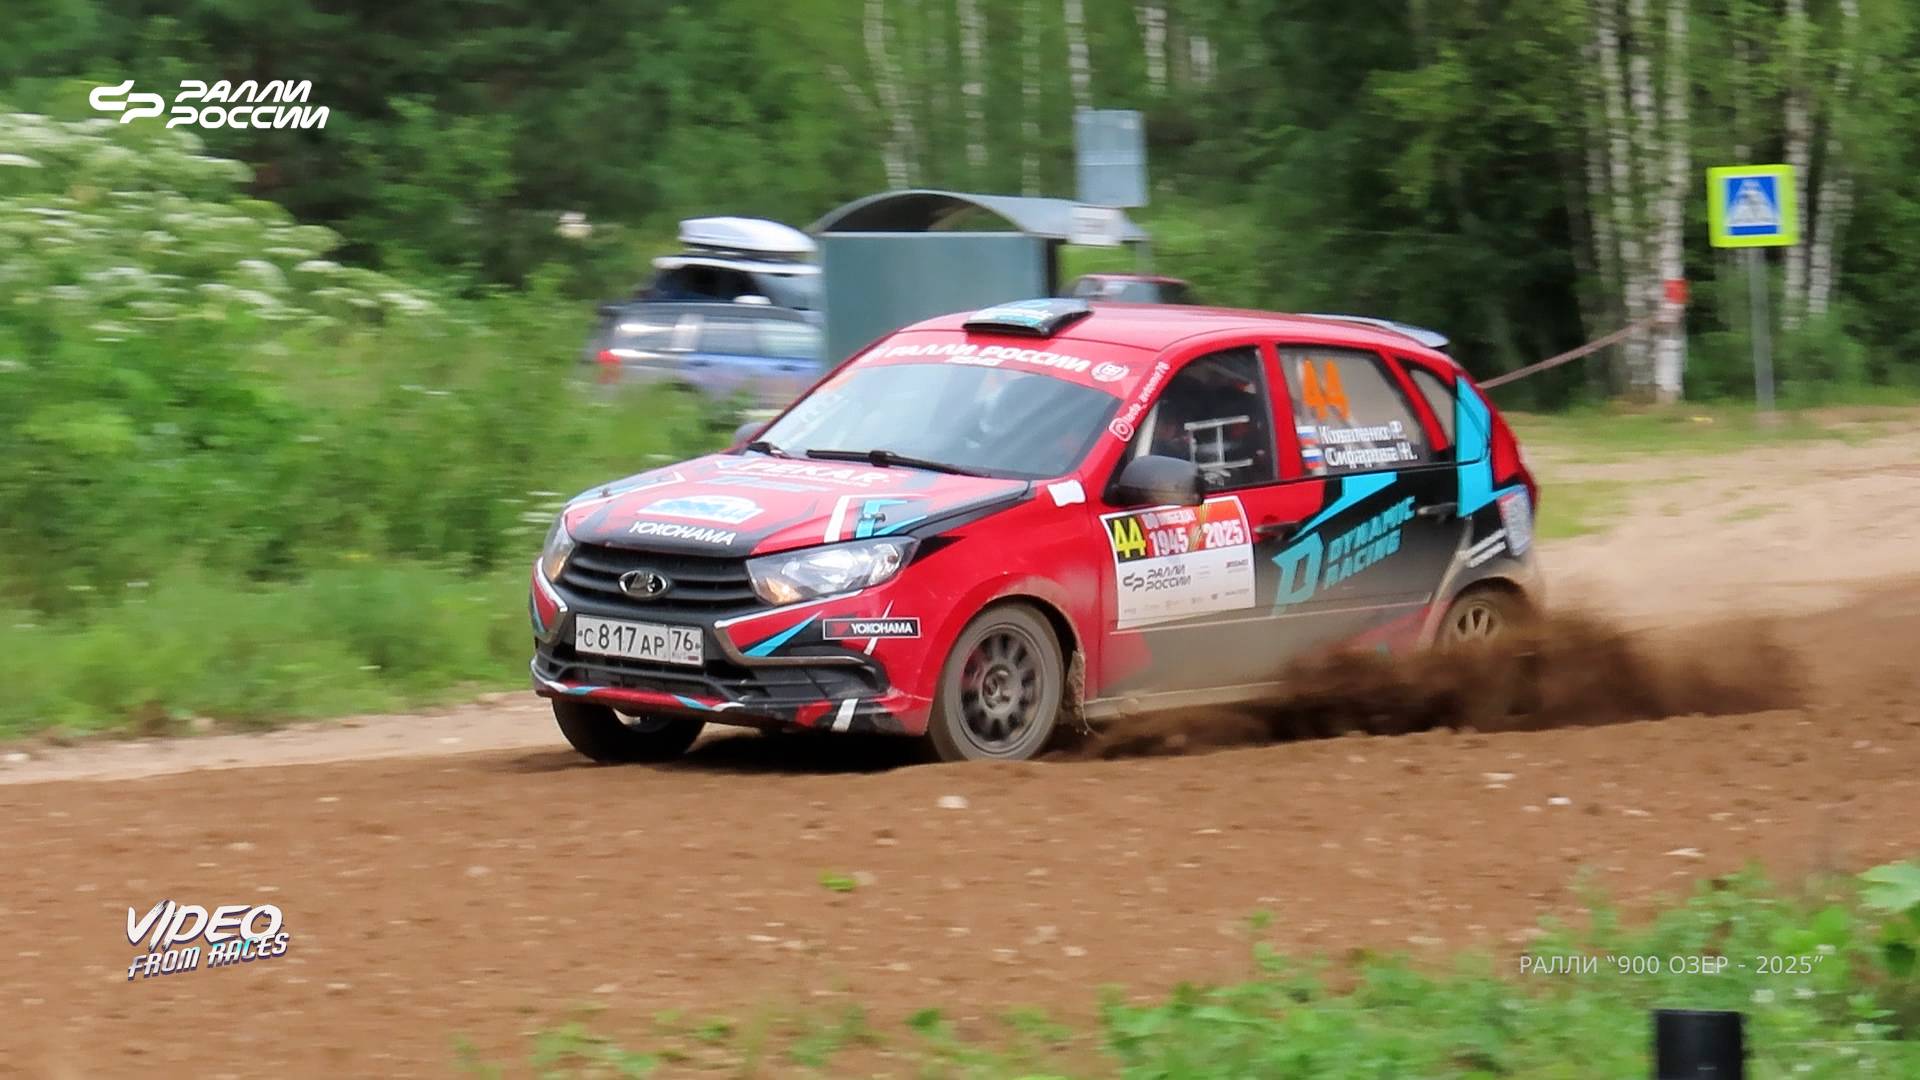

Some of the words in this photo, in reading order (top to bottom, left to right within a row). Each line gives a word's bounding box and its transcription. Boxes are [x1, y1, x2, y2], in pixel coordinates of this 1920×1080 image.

[978, 344, 1092, 374] РОССИИ
[1302, 358, 1350, 422] 44
[629, 521, 737, 545] YOKOHAMA
[1113, 517, 1147, 559] 44
[1149, 526, 1189, 557] 1945
[1203, 518, 1245, 549] 2025
[1328, 495, 1416, 563] DYNAMIC
[1147, 564, 1187, 580] РАЛЛИ
[1322, 528, 1402, 590] RACING
[1145, 575, 1192, 592] РОССИИ
[672, 630, 694, 652] 76
[851, 622, 913, 635] YOKOHAMA
